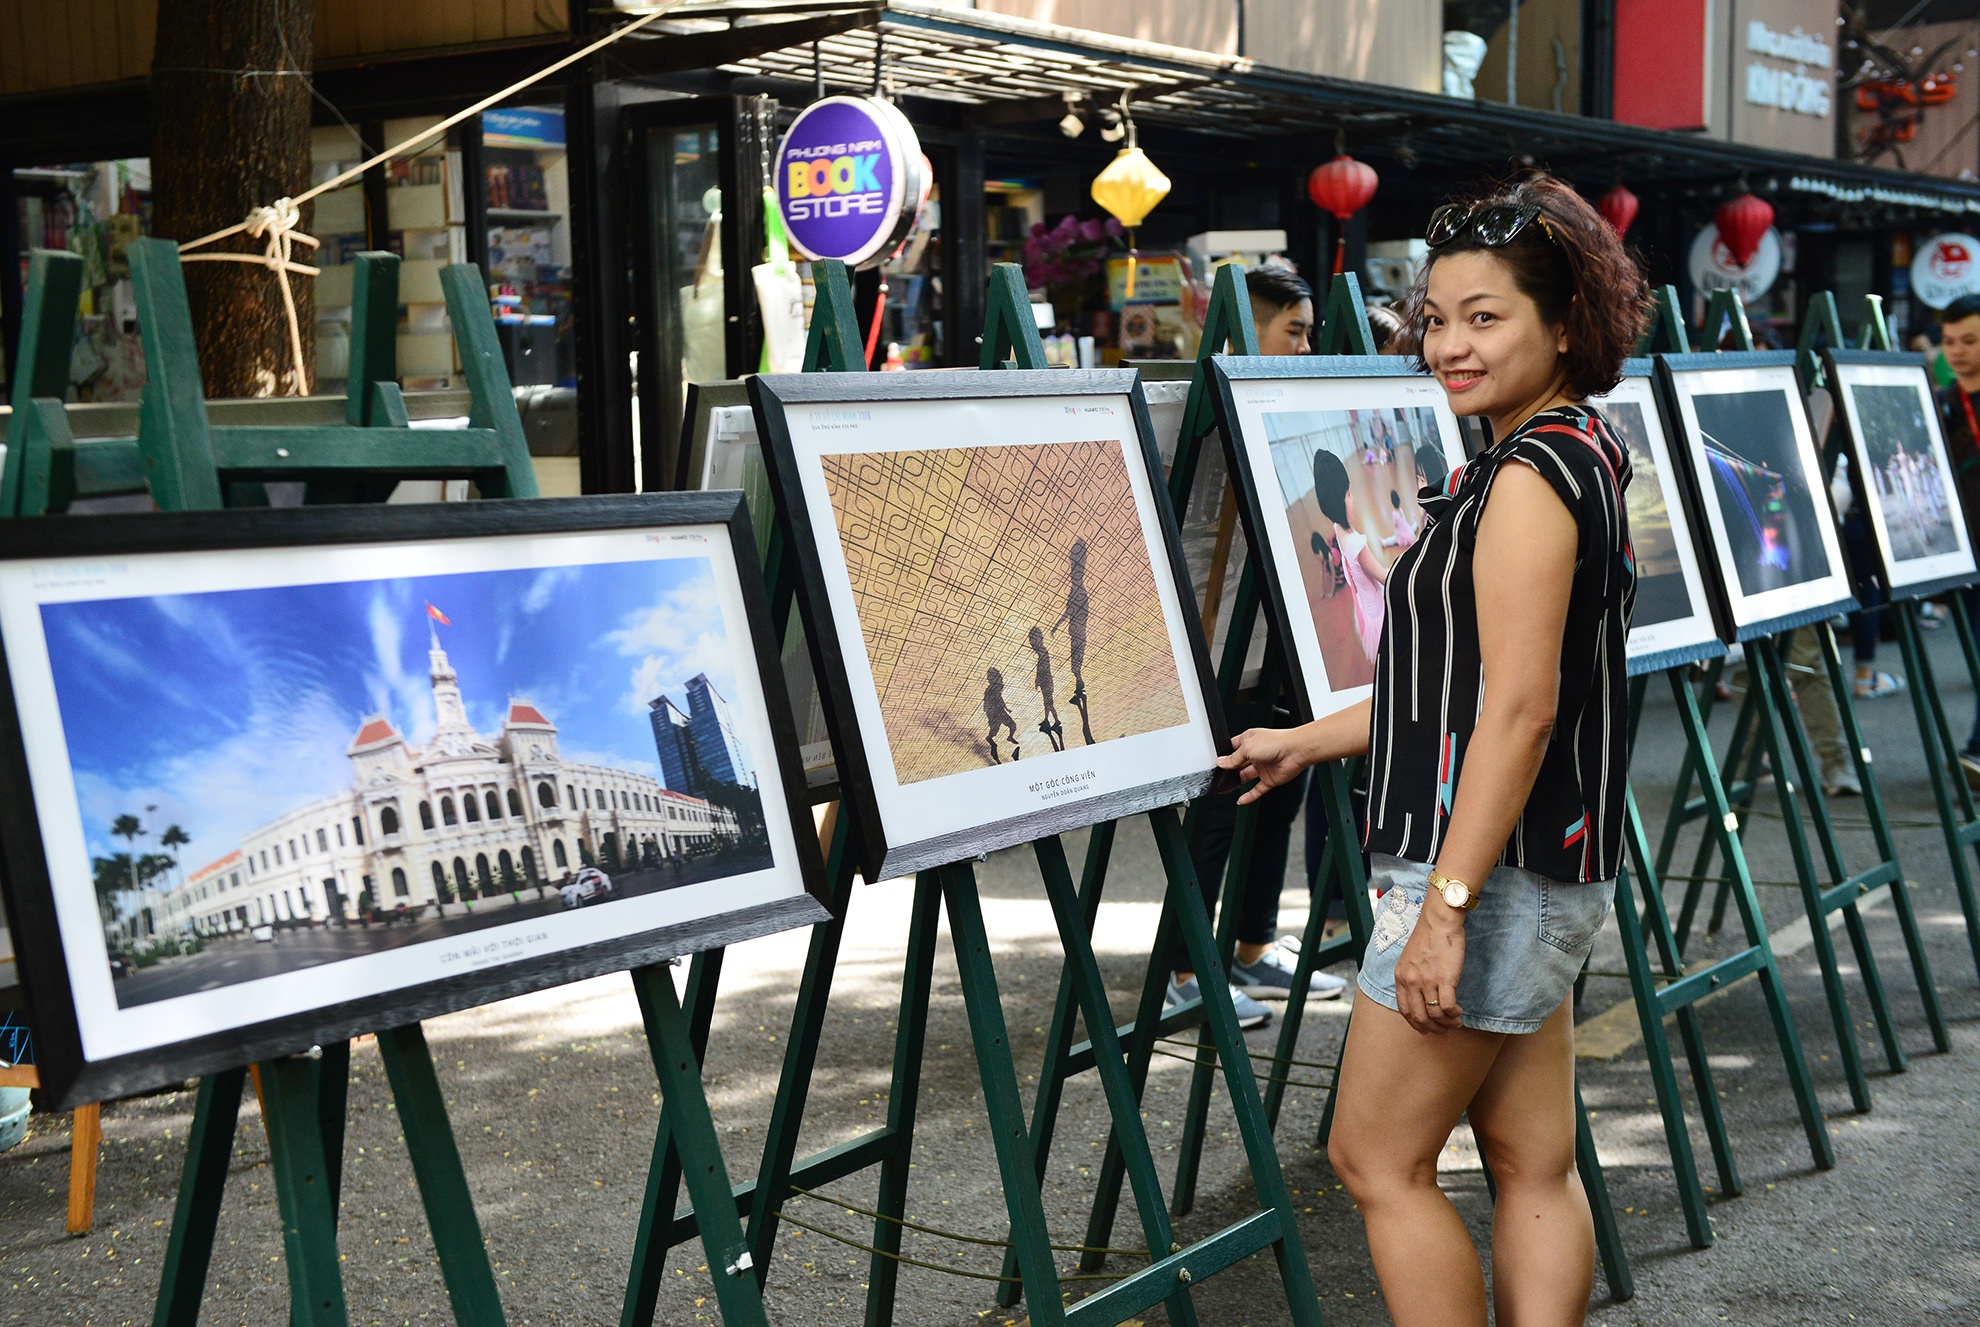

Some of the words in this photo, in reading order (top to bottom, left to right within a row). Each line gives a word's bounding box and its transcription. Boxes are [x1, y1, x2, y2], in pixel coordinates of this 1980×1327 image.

[848, 140, 882, 153] NAM
[788, 153, 882, 199] BOOK
[788, 192, 884, 221] STORE
[858, 410, 872, 420] 2018
[1028, 781, 1044, 793] MỘT
[1045, 777, 1060, 789] GÓC
[1061, 774, 1080, 785] CÔNG
[1080, 769, 1096, 780] VIÊN
